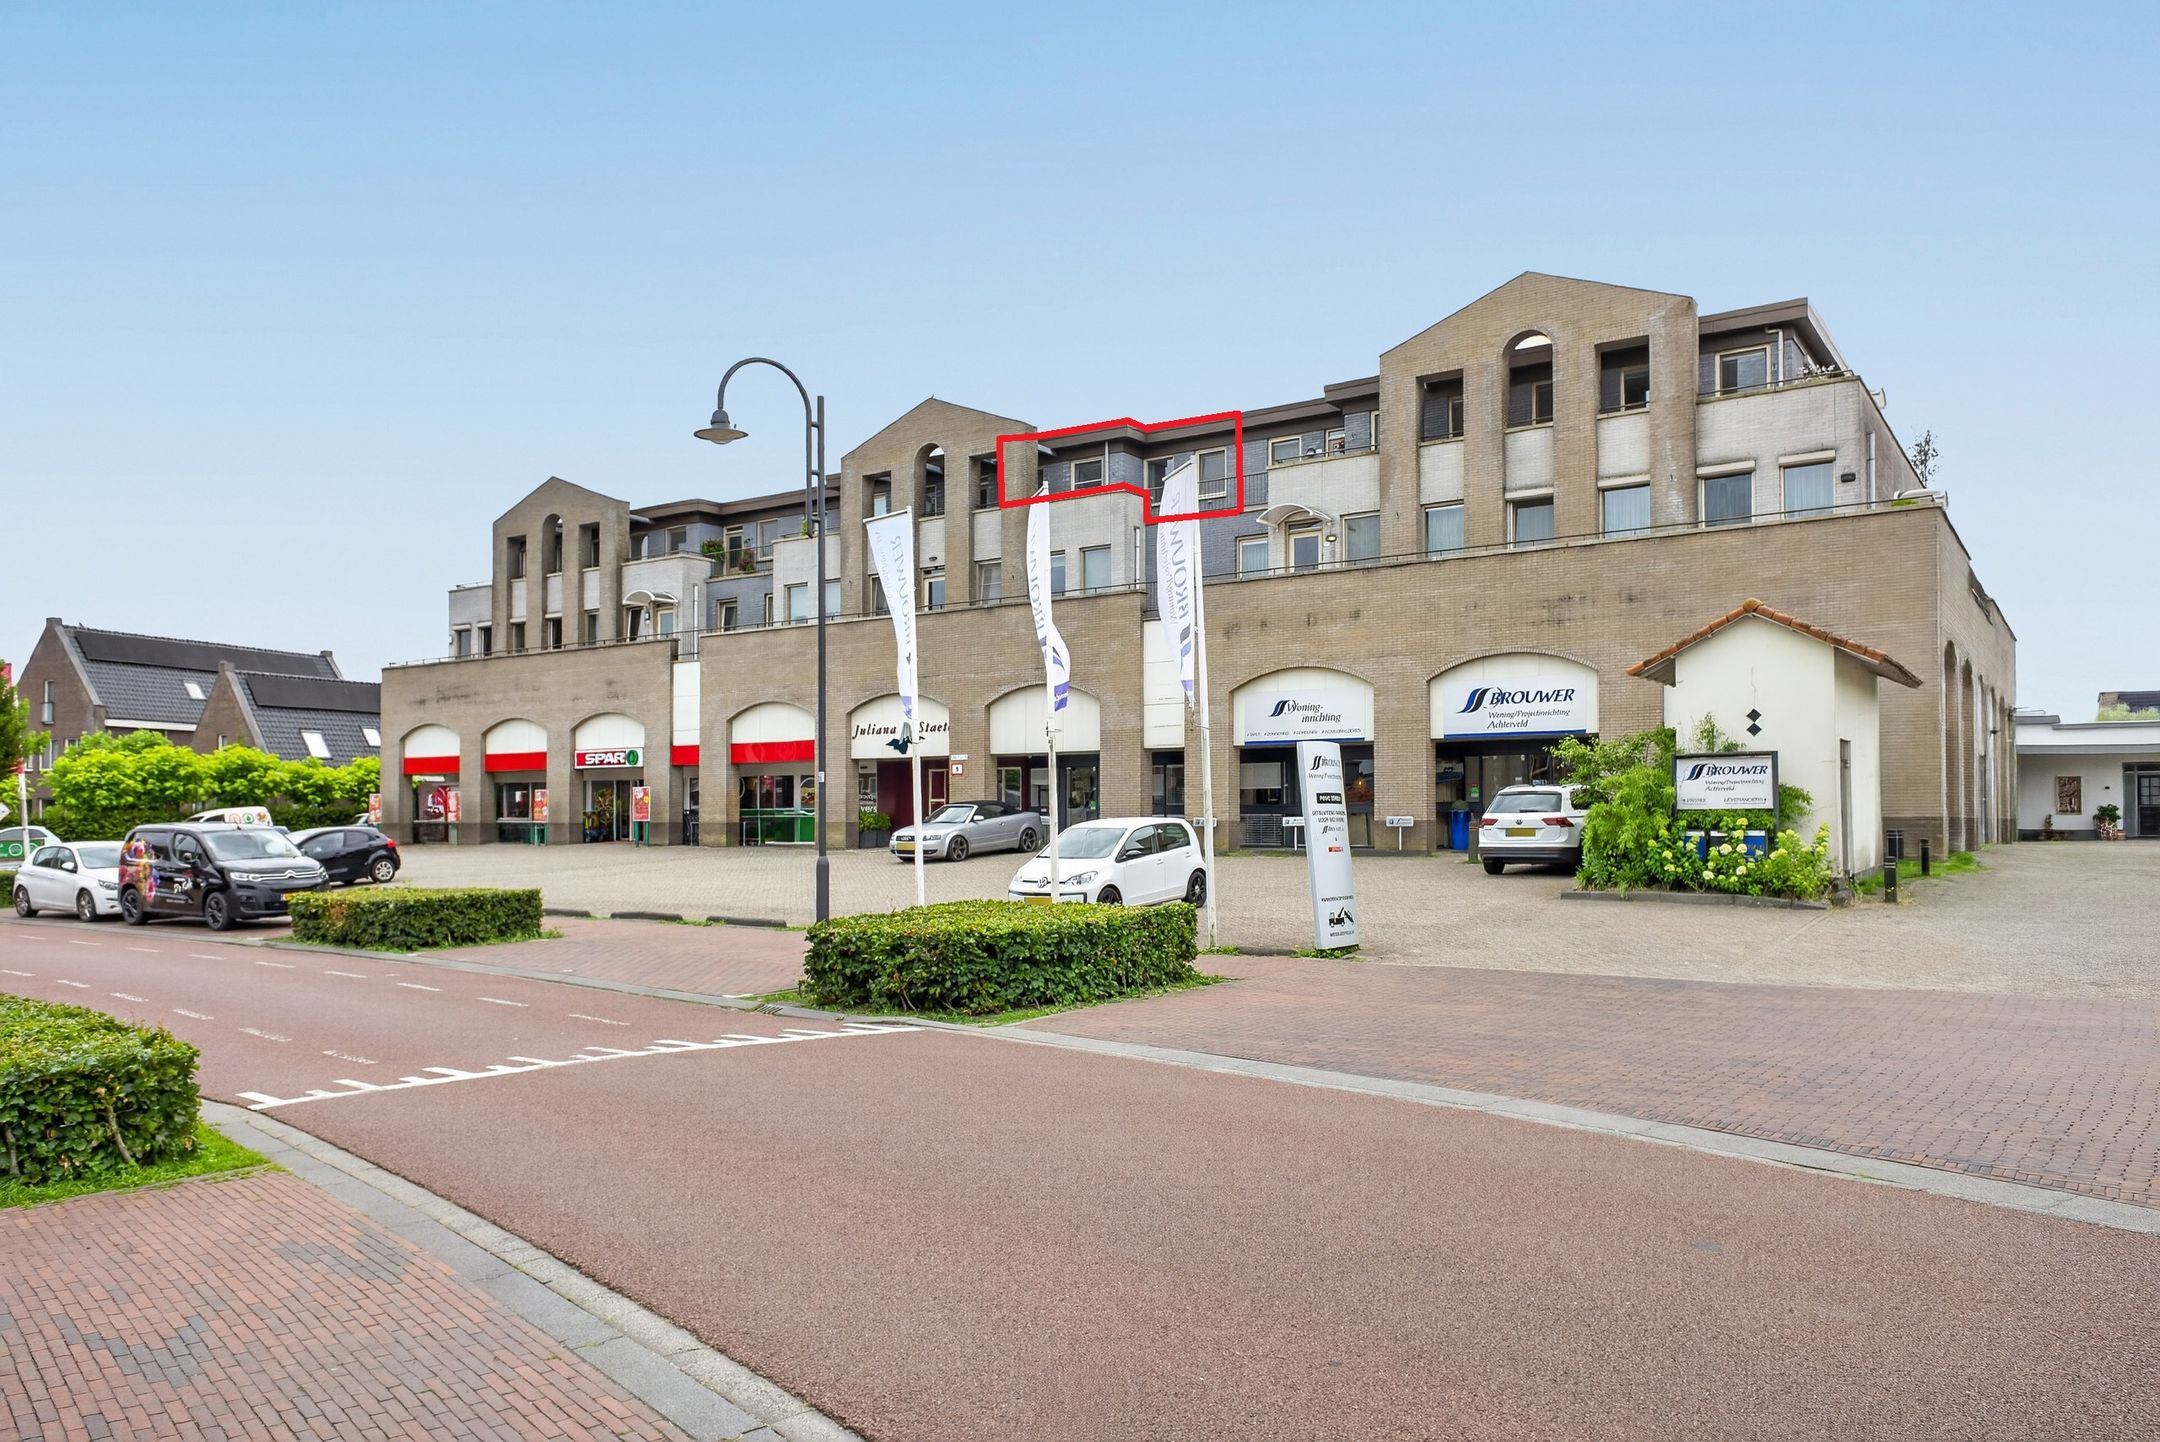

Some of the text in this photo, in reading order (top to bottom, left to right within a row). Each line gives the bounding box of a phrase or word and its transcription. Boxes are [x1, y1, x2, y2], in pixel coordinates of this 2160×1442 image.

[1489, 688, 1576, 705] BROUWER
[1287, 701, 1324, 713] Woning-
[1302, 712, 1341, 723] inrichting
[1487, 720, 1529, 729] Achterveld
[852, 723, 897, 739] Juliana
[585, 752, 626, 765] SPAR
[1705, 765, 1768, 776] BROUWER
